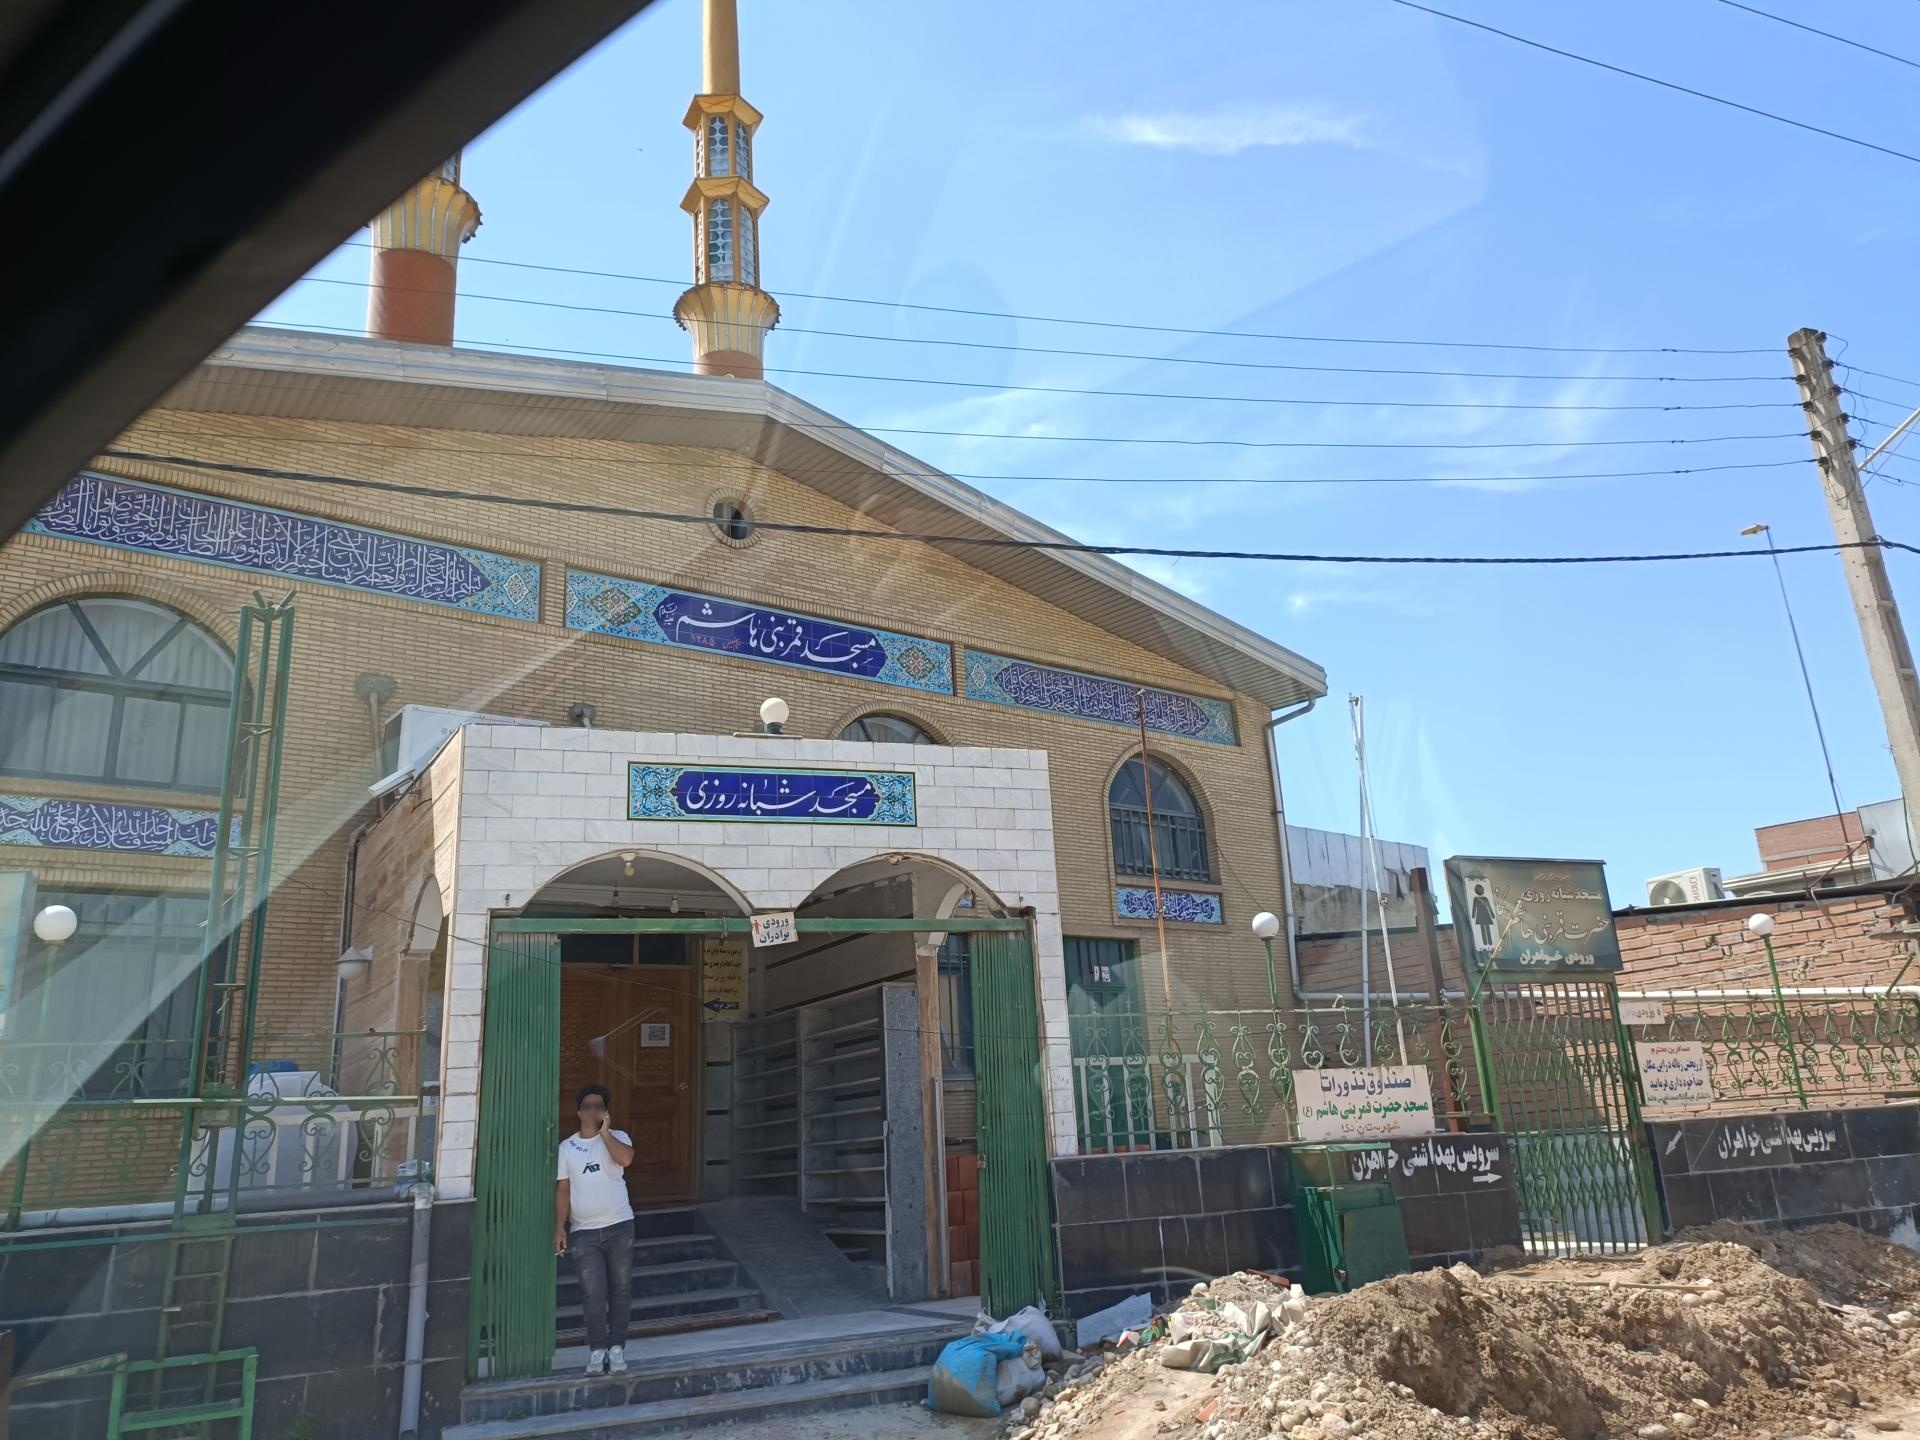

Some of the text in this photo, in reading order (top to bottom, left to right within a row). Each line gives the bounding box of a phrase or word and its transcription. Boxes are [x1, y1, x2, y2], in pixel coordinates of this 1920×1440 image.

[676, 602, 876, 668] مسجد قمر بنی هاشم
[686, 778, 872, 815] مسجد شبانه روزی
[762, 918, 789, 930] ورودی
[760, 929, 790, 943] برادران
[1520, 949, 1596, 965] ورودی خواهران
[1366, 1071, 1412, 1096] صندوق
[1316, 1100, 1339, 1120] هاشم
[1340, 1101, 1357, 1121] بنی
[1358, 1096, 1374, 1120] قمر
[1373, 1096, 1401, 1119] حضرت
[1403, 1101, 1429, 1117] مسجد
[1718, 1122, 1836, 1160] سرویس بهداشتی خواهران
[1402, 1138, 1457, 1177] بهداشتی
[1457, 1143, 1500, 1172] سرویس
